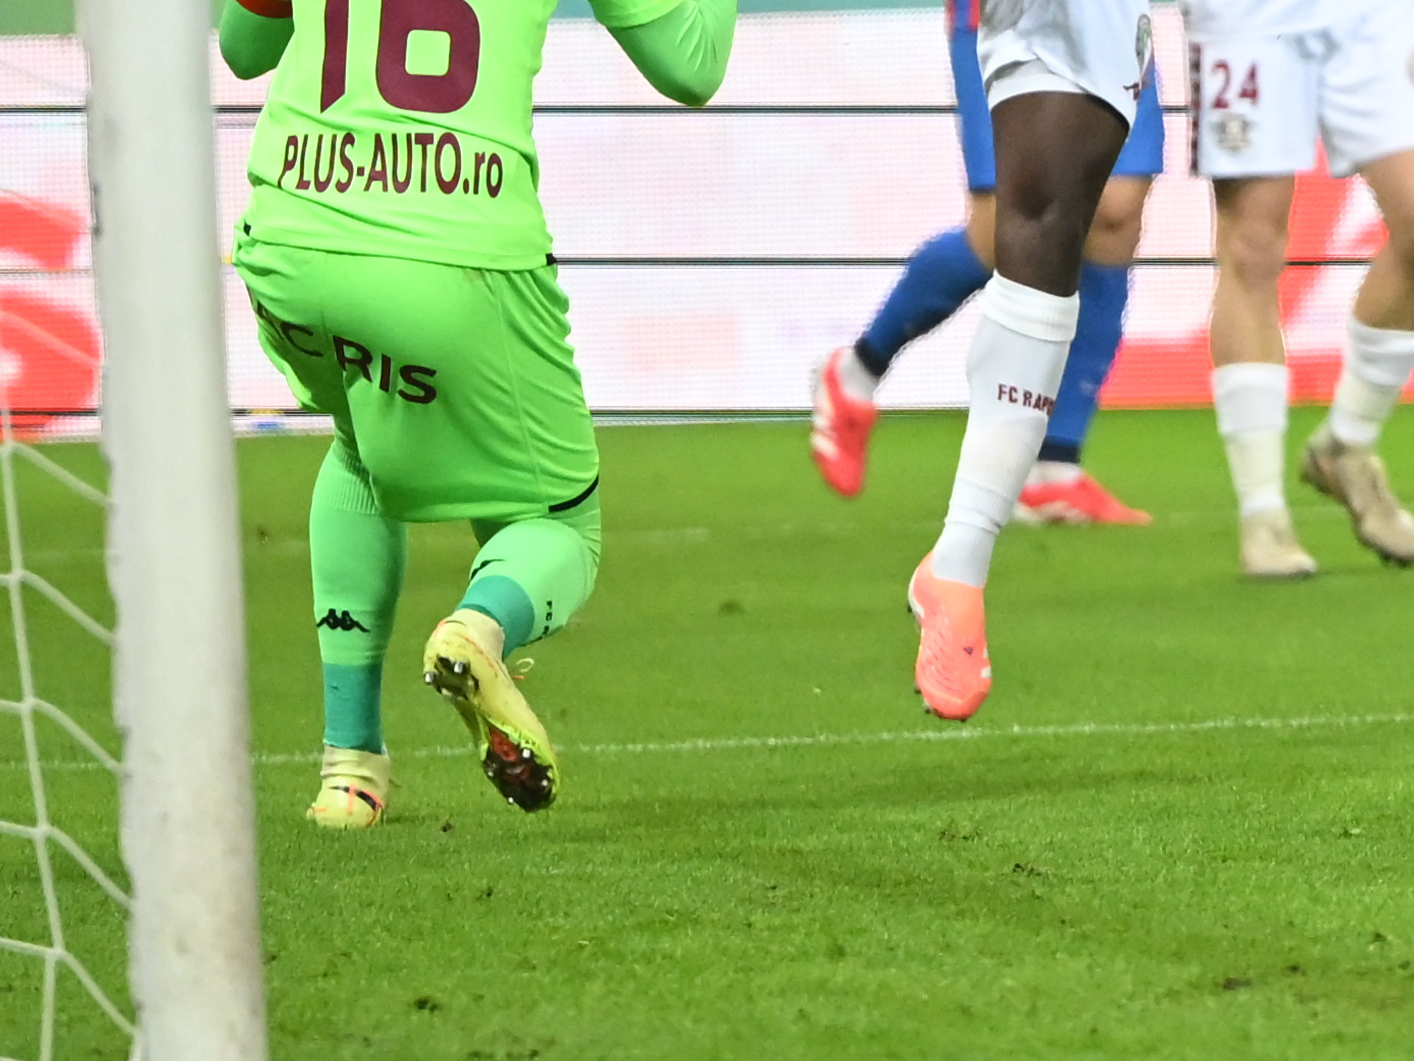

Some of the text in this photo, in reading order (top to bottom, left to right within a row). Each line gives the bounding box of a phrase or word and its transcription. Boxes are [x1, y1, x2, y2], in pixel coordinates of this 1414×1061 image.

[1211, 59, 1259, 110] 24
[277, 131, 503, 199] PLUS-AUTO.ro
[997, 383, 1019, 404] FC
